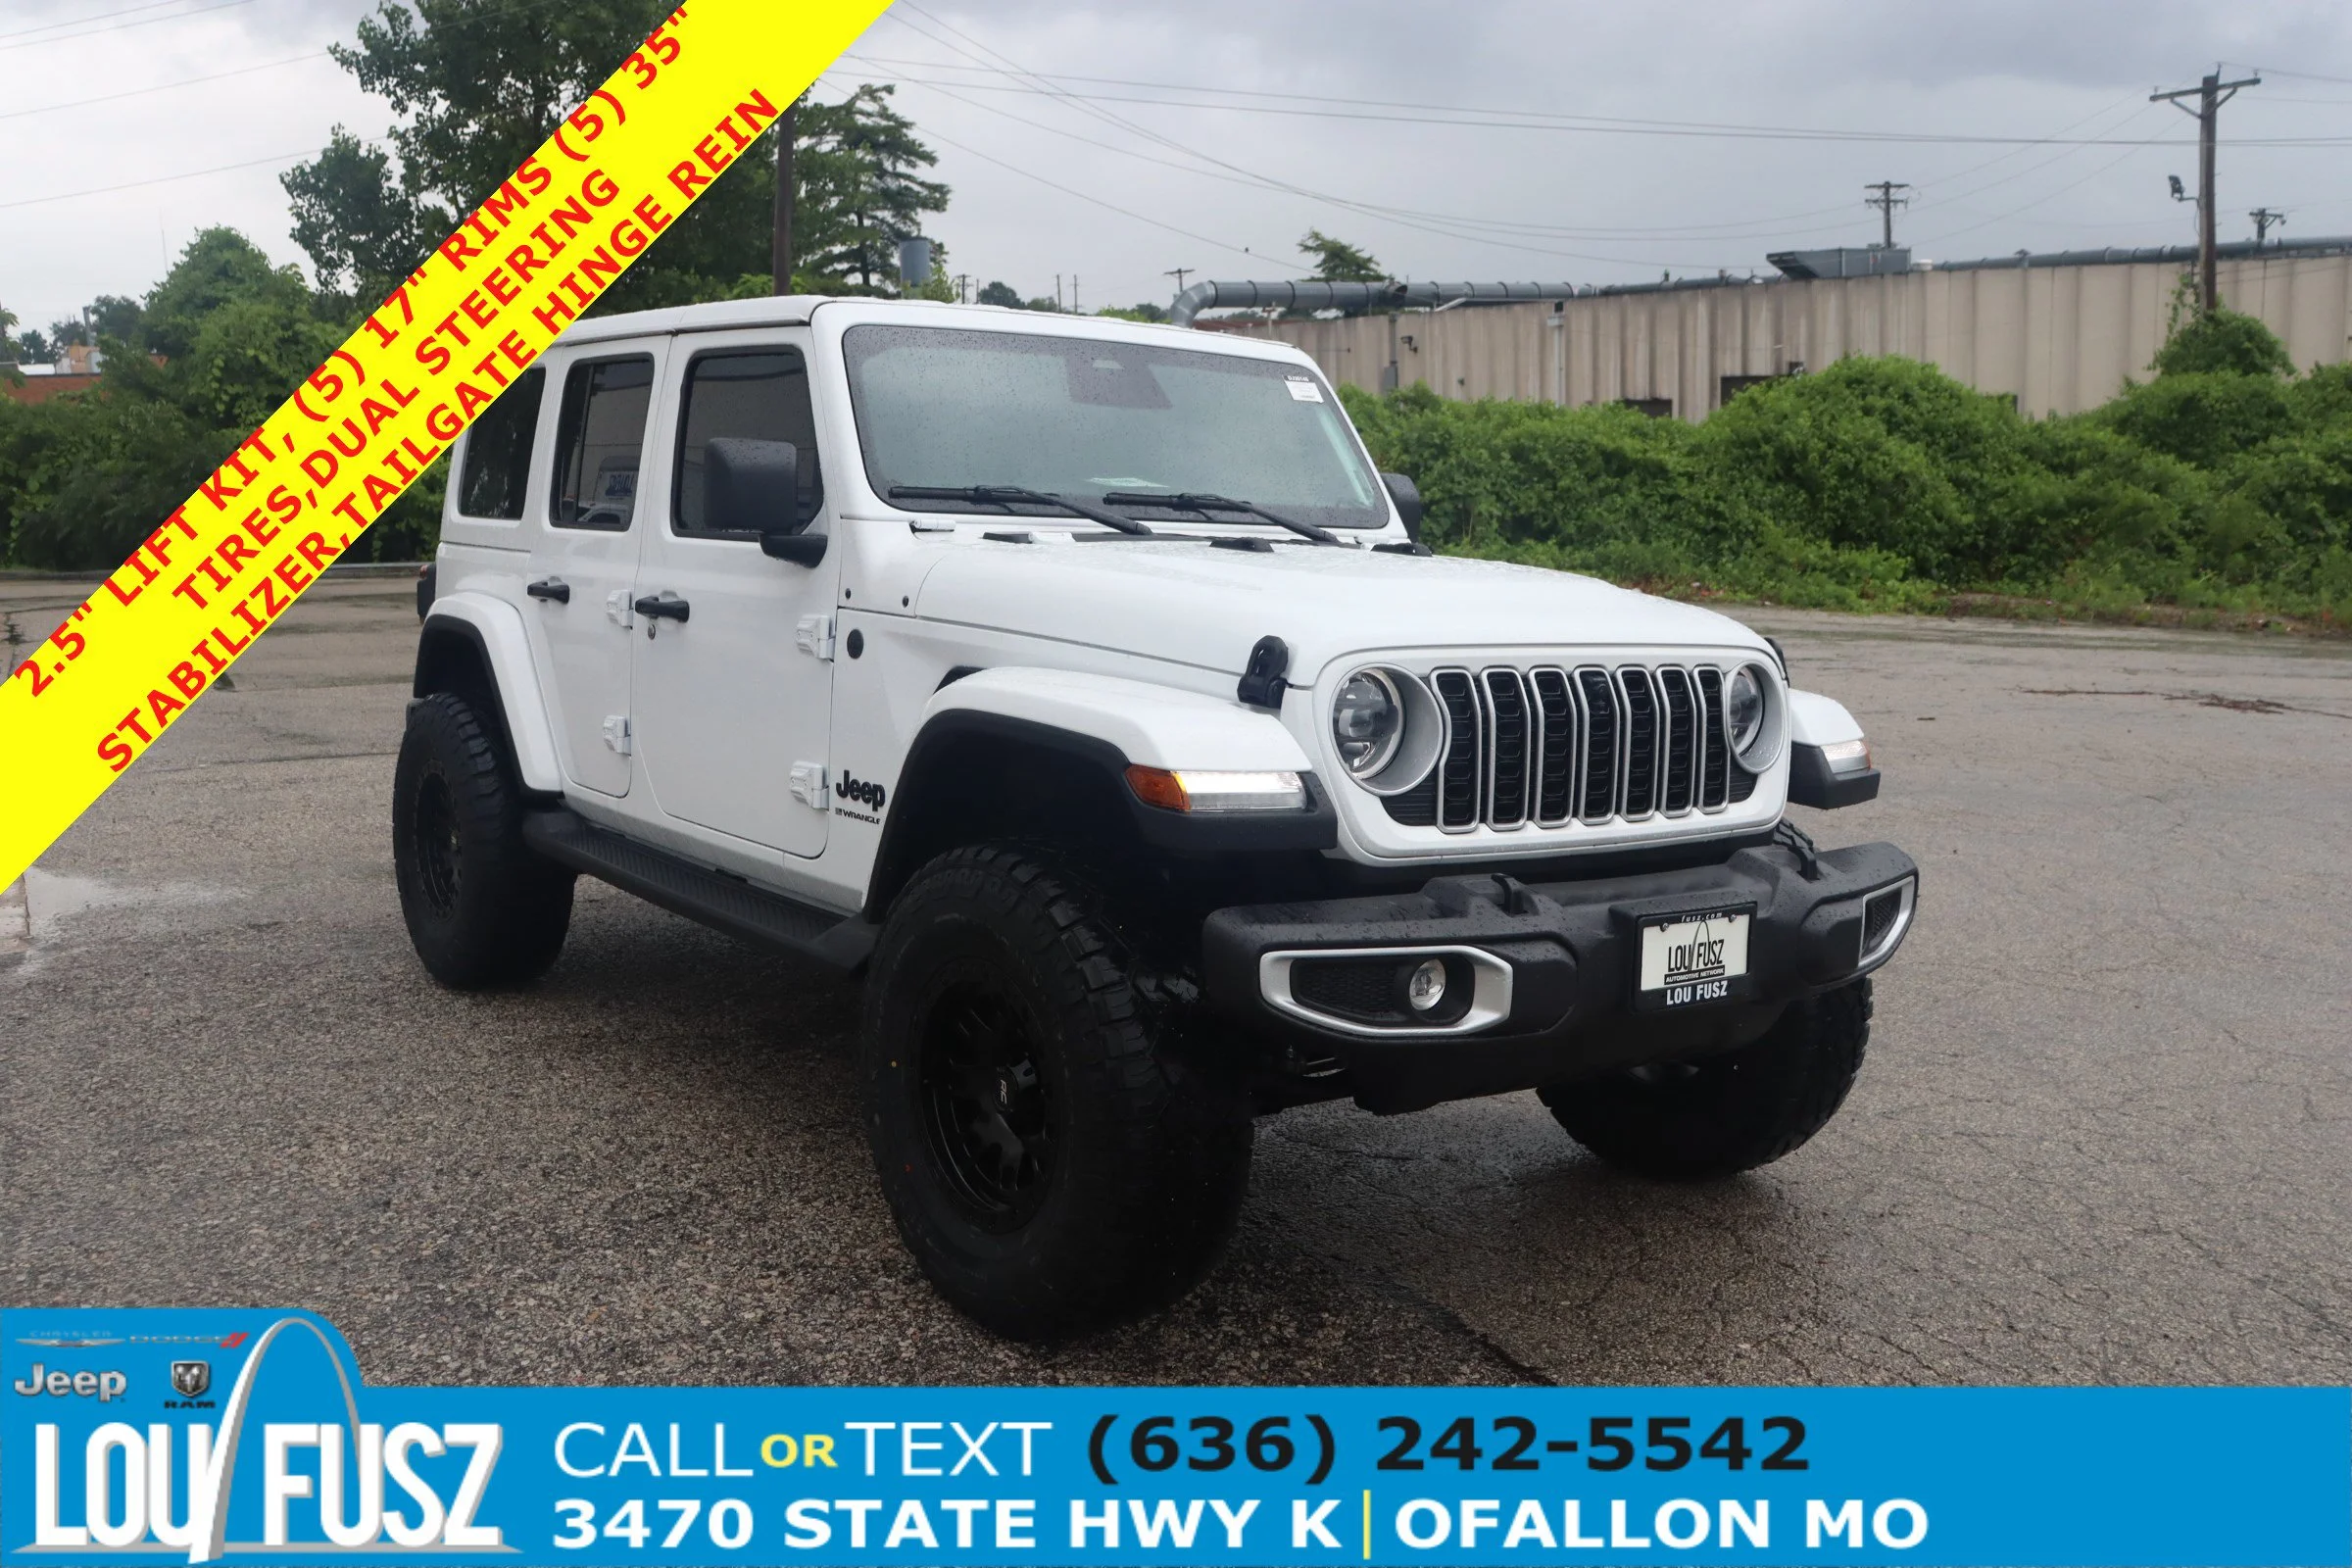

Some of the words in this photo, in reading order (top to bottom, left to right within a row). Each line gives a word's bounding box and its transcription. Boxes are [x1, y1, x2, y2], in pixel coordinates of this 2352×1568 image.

[835, 769, 886, 812] Jeep
[1681, 912, 1723, 923] fusz.com
[1668, 944, 1692, 972] LOU
[1696, 939, 1725, 968] FUSZ
[1665, 972, 1699, 983] AUTOMOTIVE
[1699, 968, 1725, 977] NETWORK
[1666, 986, 1691, 1005] LOU
[1696, 980, 1728, 1001] FUSZ
